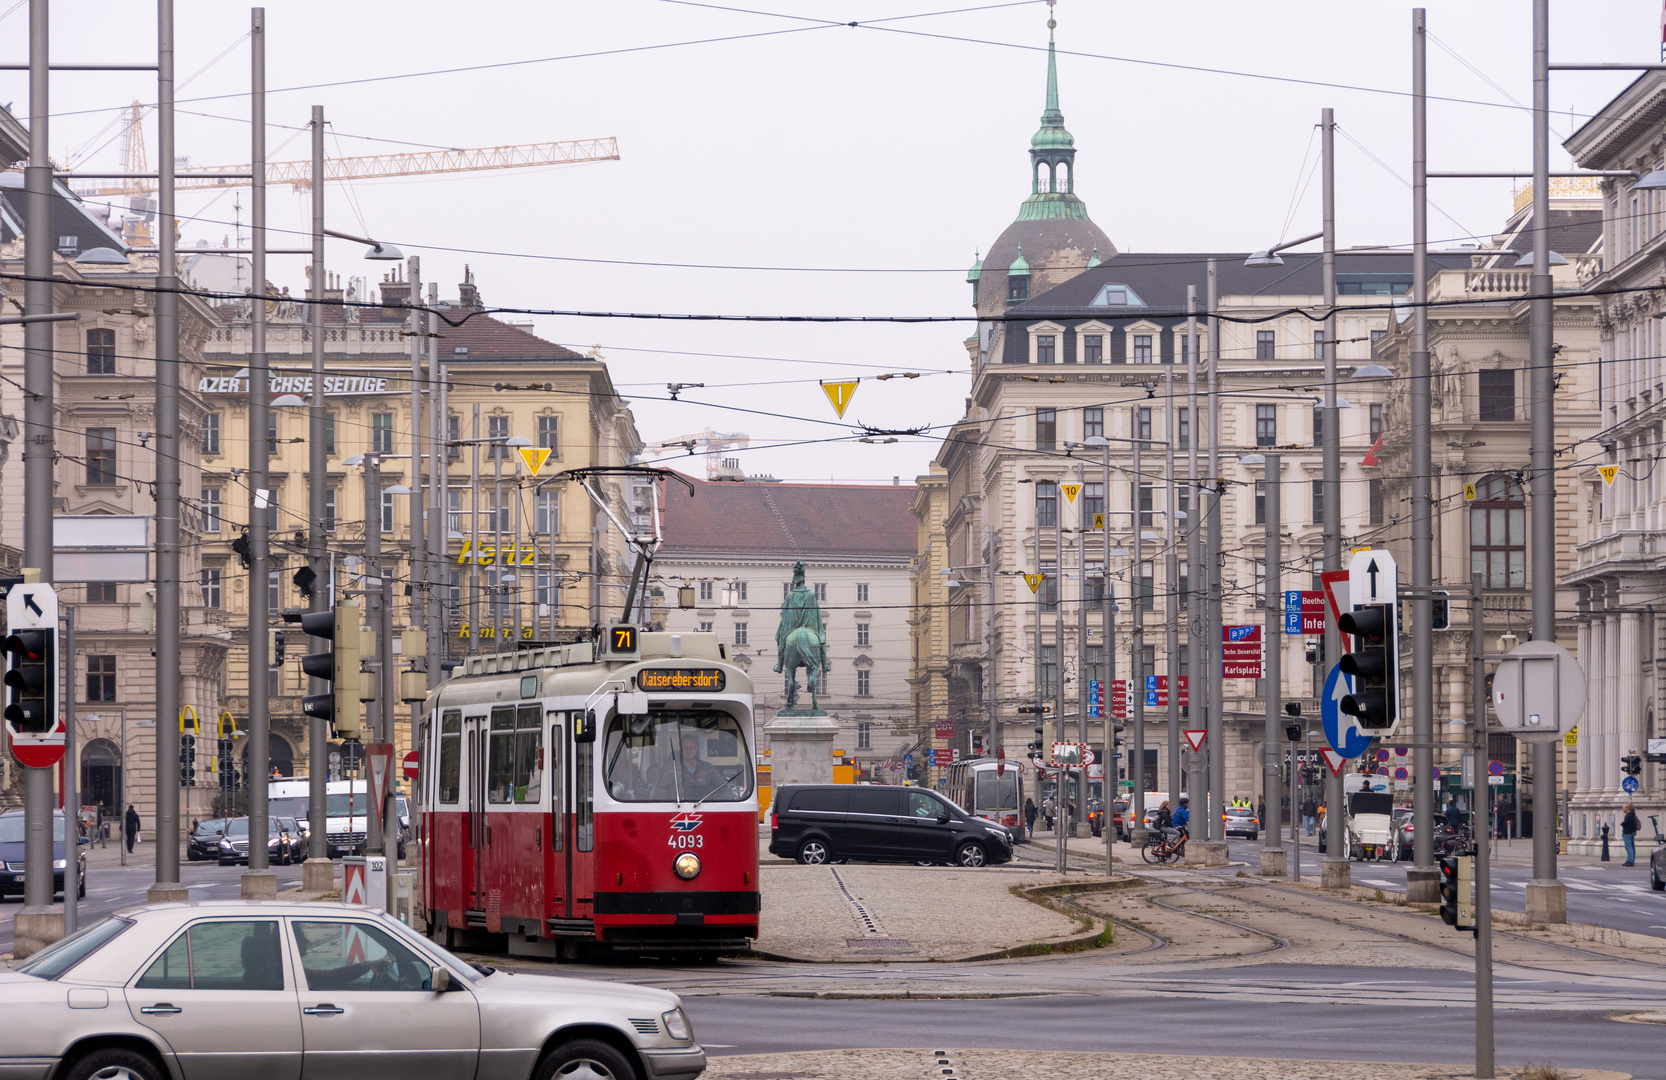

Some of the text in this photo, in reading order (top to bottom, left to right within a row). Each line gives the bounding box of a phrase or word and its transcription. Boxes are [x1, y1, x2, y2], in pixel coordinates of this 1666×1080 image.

[1604, 468, 1614, 477] 10
[1066, 486, 1077, 495] 10
[1467, 486, 1474, 495] A
[1095, 516, 1103, 525] A
[1302, 597, 1325, 605] Beetho
[616, 631, 631, 648] 71
[1225, 666, 1260, 676] Karlsplatz
[642, 670, 719, 687] Kaiserebersdorf
[668, 835, 703, 849] 4093
[371, 861, 384, 870] 102
